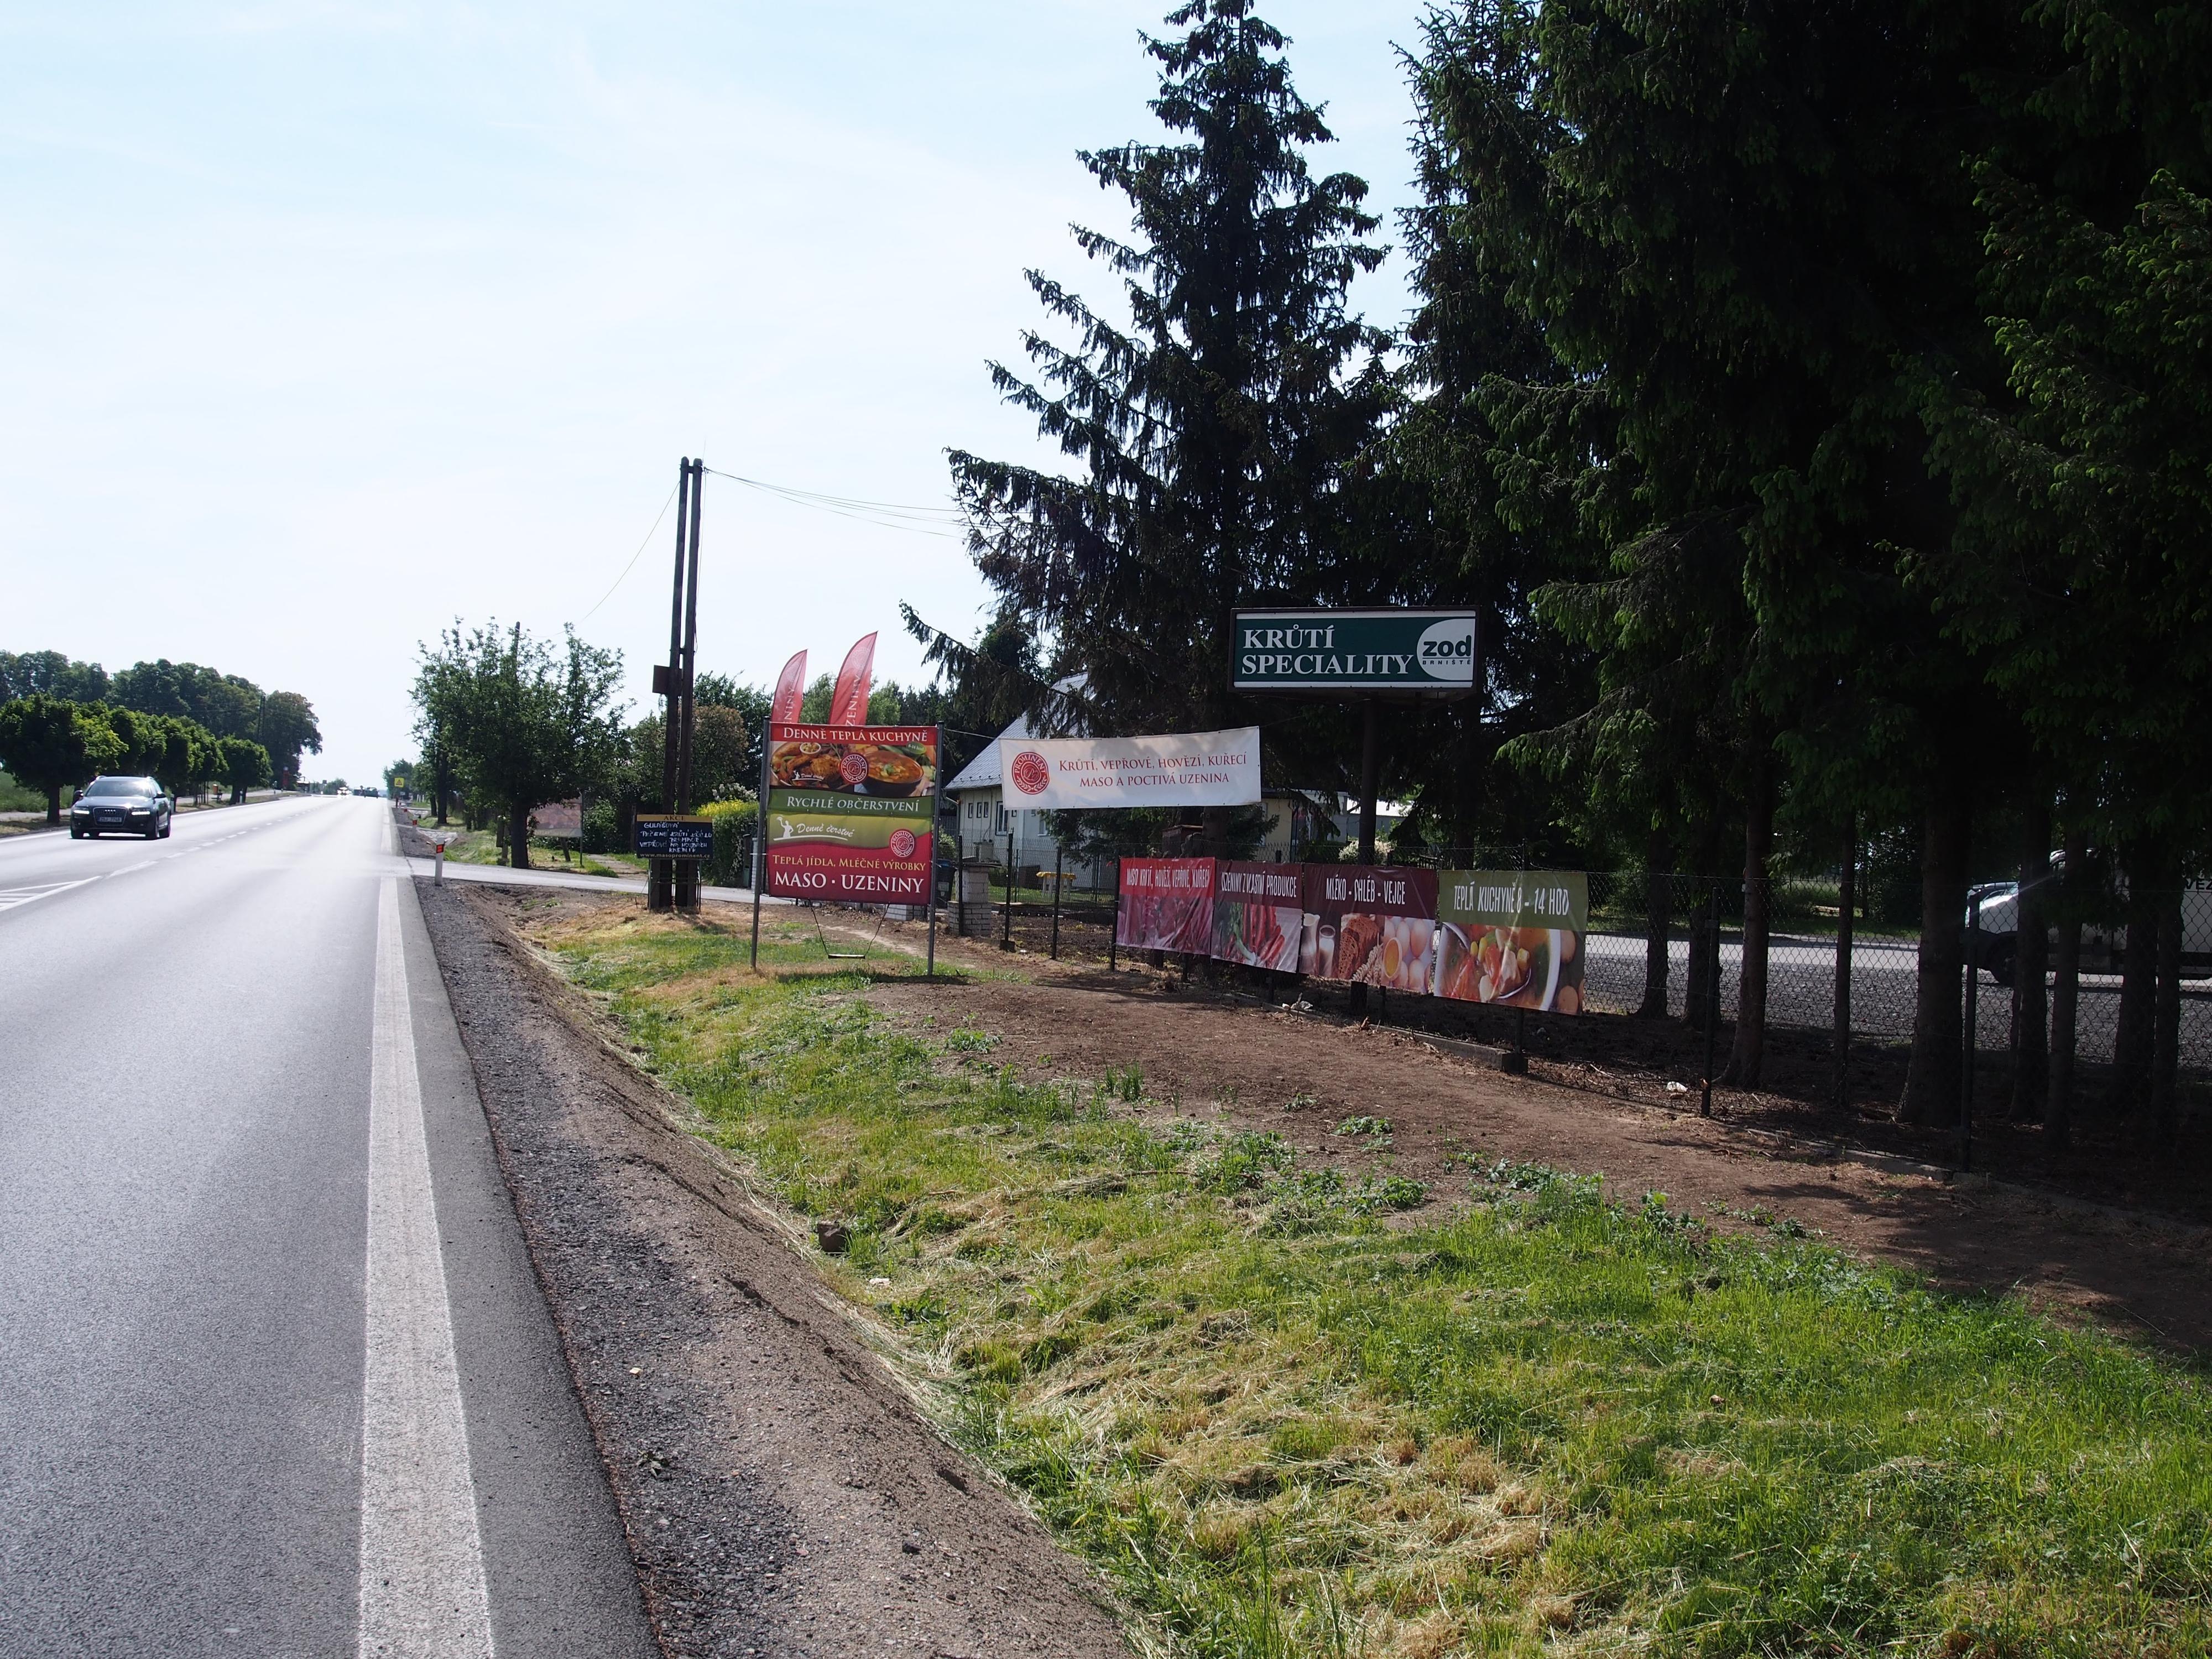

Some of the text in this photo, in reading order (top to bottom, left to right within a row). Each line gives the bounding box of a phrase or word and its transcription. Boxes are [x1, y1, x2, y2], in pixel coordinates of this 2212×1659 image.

[1243, 624, 1335, 649] KRŮTÍ
[1422, 635, 1472, 657] zod
[1242, 654, 1413, 675] SPECIALITY
[783, 727, 927, 742] DENNĚ TEPLÁ KUCHYNĚ
[1015, 754, 1046, 774] PROMINENT
[1059, 752, 1247, 772] KRŮTÍ, VEPŘOVÉ, HOVĚZÍ, KUŘECÍ
[1079, 773, 1229, 787] MASO A POCTIVÁ UZENINA
[787, 796, 919, 812] RYCHLÉ OBČERSTVENÍ
[797, 823, 855, 837] Denně čerstvé
[773, 855, 926, 871] TEPLÁ JÍDLA, MLÉČNÉ VÝROBKY
[774, 872, 924, 893] MASO UZENINY
[1126, 868, 1139, 886] MASO
[1222, 872, 1243, 893] UZENINY
[1266, 875, 1297, 898] PRODUKCE
[1326, 874, 1347, 901] MLÉKO
[1354, 875, 1375, 902] CHLÉB
[1384, 880, 1405, 905] VEJCE
[1454, 881, 1475, 911] TEPLÁ
[1478, 882, 1516, 913] KUCHYNĚ
[1517, 887, 1522, 914] 8
[1535, 888, 1545, 914] 14
[1549, 888, 1569, 915] HOD
